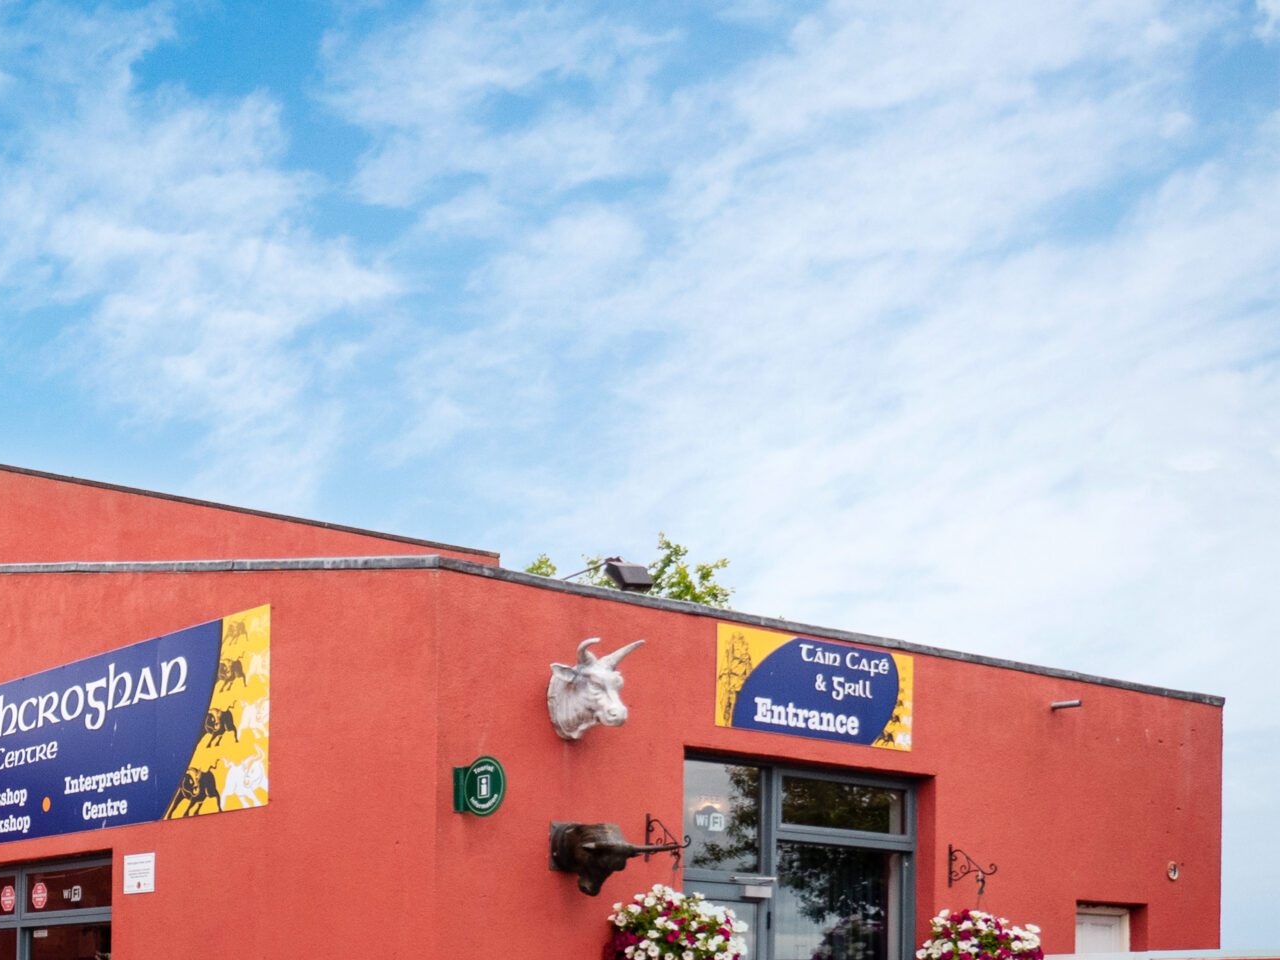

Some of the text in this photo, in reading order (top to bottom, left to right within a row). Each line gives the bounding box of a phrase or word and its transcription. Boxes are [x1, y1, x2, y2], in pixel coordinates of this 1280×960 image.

[815, 673, 826, 691] &
[754, 696, 859, 735] Entrance
[64, 764, 149, 795] Interpretive
[82, 799, 128, 820] Centre
